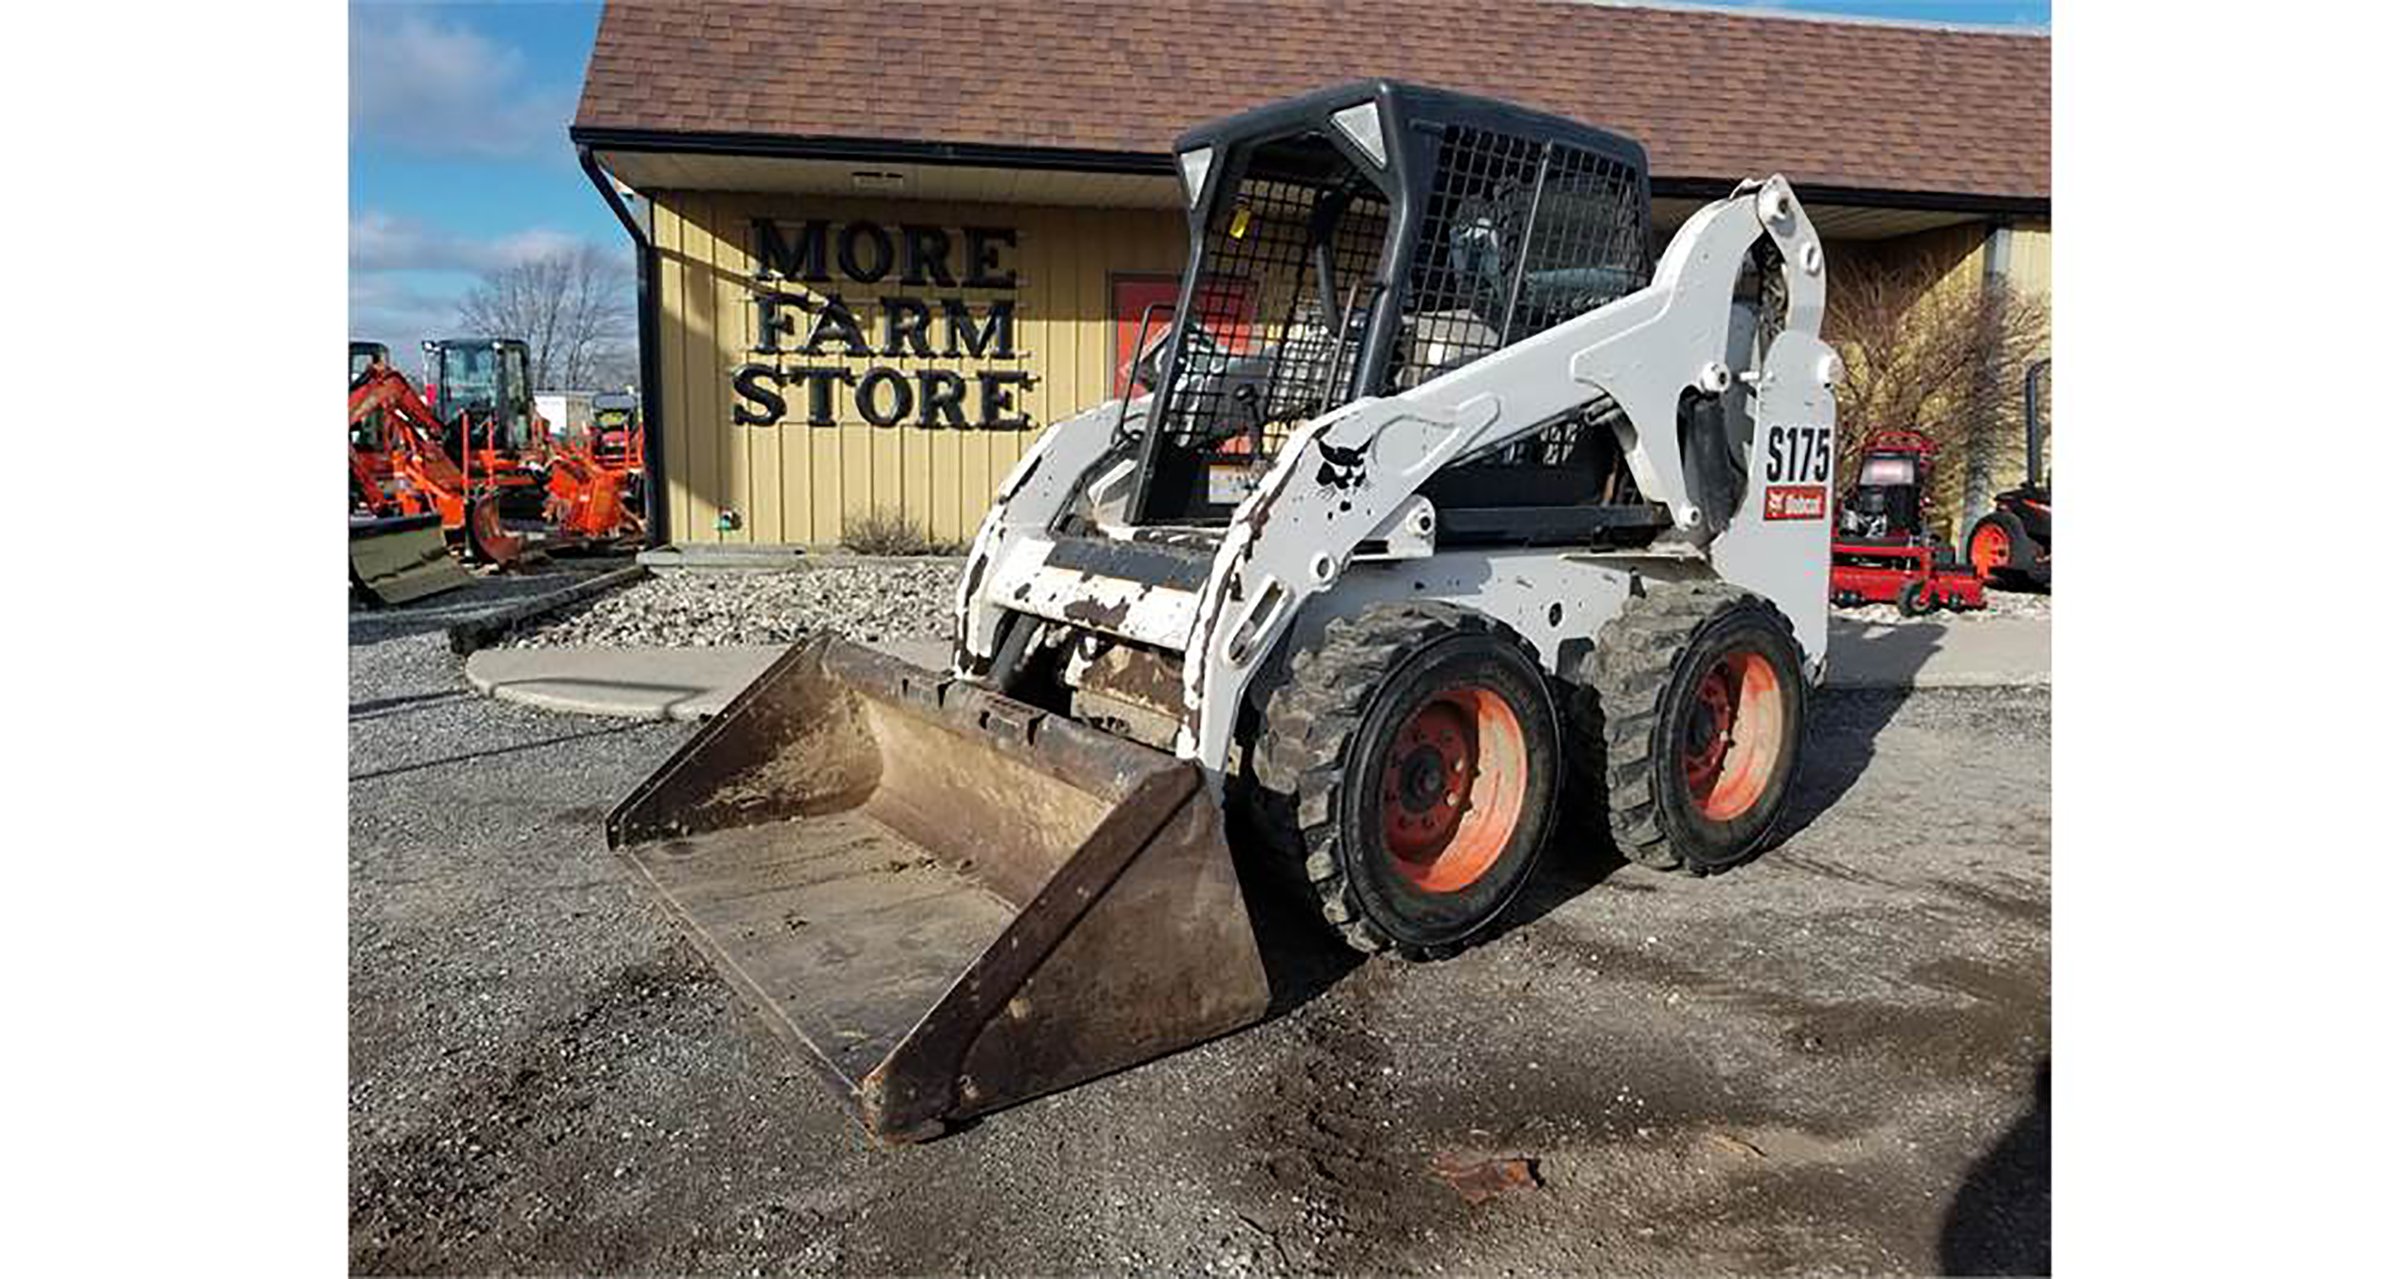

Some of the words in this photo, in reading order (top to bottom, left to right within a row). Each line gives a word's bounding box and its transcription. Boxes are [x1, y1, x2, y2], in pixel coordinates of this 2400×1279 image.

[752, 217, 1017, 289] MORE
[754, 294, 1016, 359] FARM
[732, 364, 1041, 431] STORE
[1766, 426, 1830, 482] S175
